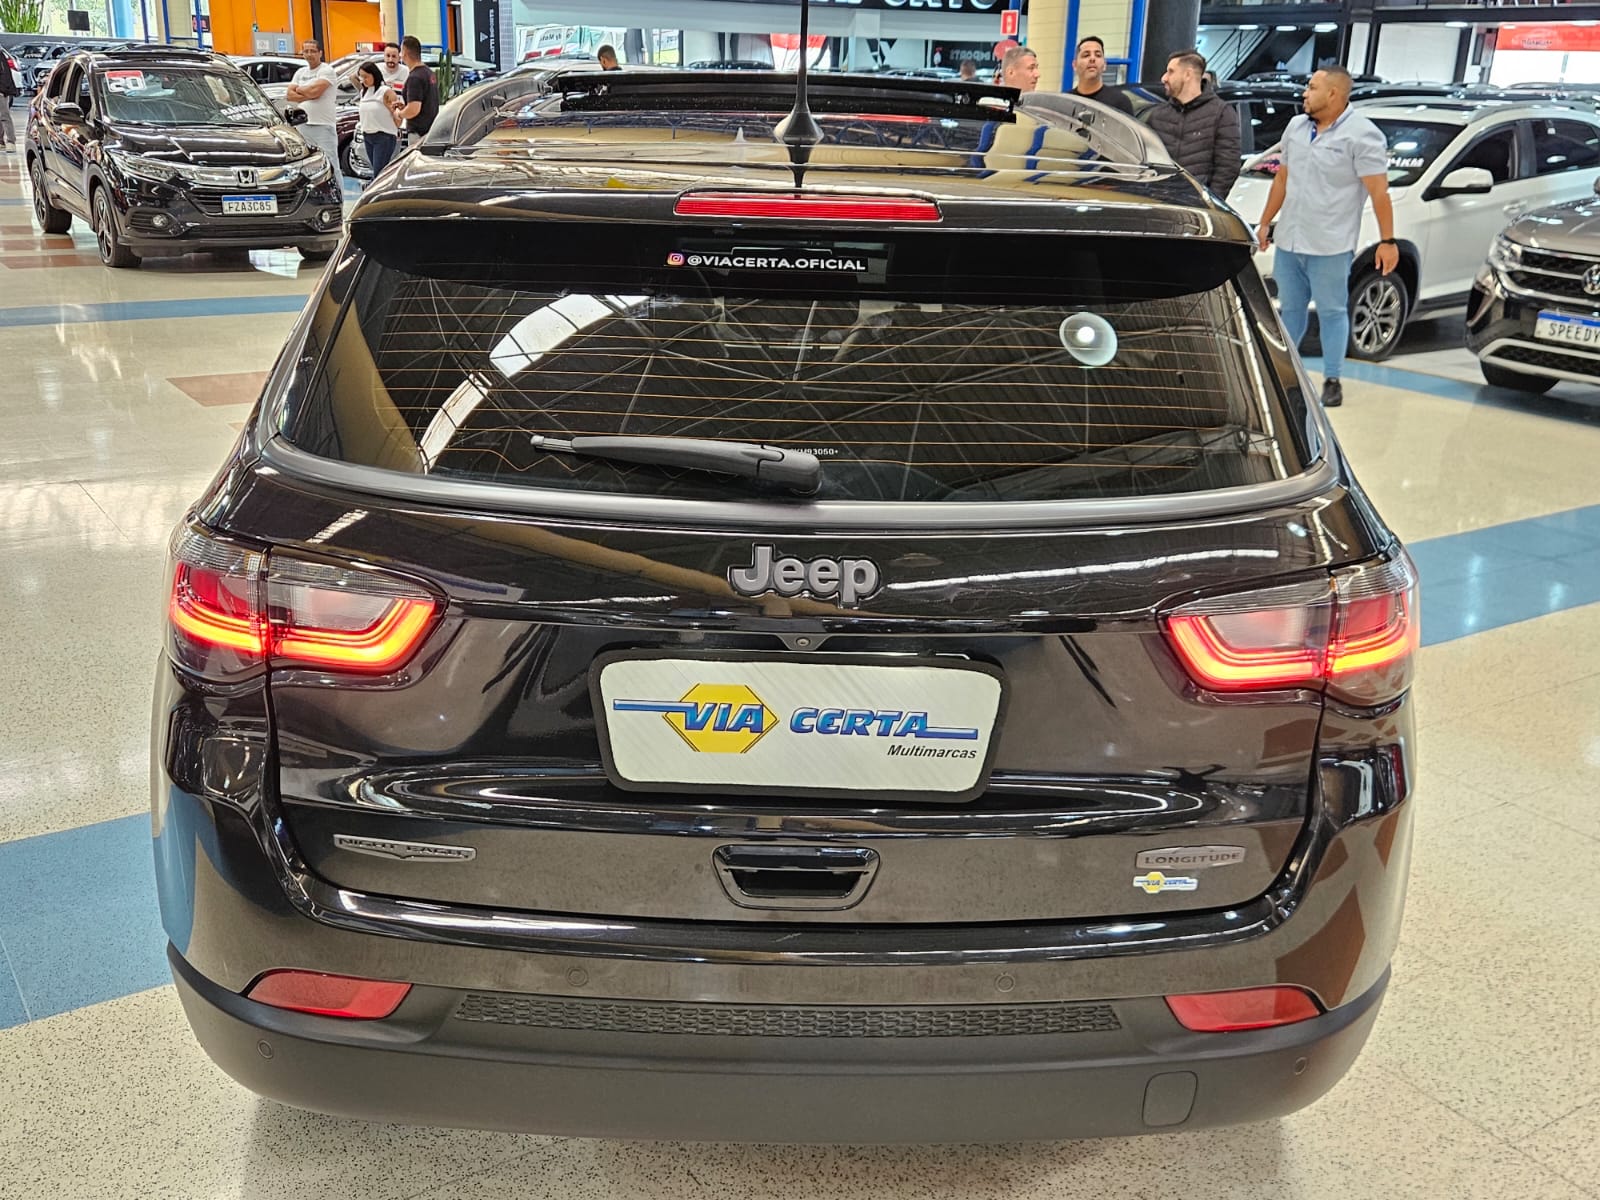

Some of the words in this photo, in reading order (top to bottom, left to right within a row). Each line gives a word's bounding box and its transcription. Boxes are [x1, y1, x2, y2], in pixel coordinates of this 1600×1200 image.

[228, 201, 272, 212] FZA3C85
[687, 254, 866, 271] @VIACERTA.OFICIAL
[731, 545, 878, 603] Jeep
[684, 702, 764, 733] VIA
[789, 706, 928, 738] CERTA
[887, 744, 977, 760] Multimarcas
[1144, 852, 1242, 864] LONGITUDE
